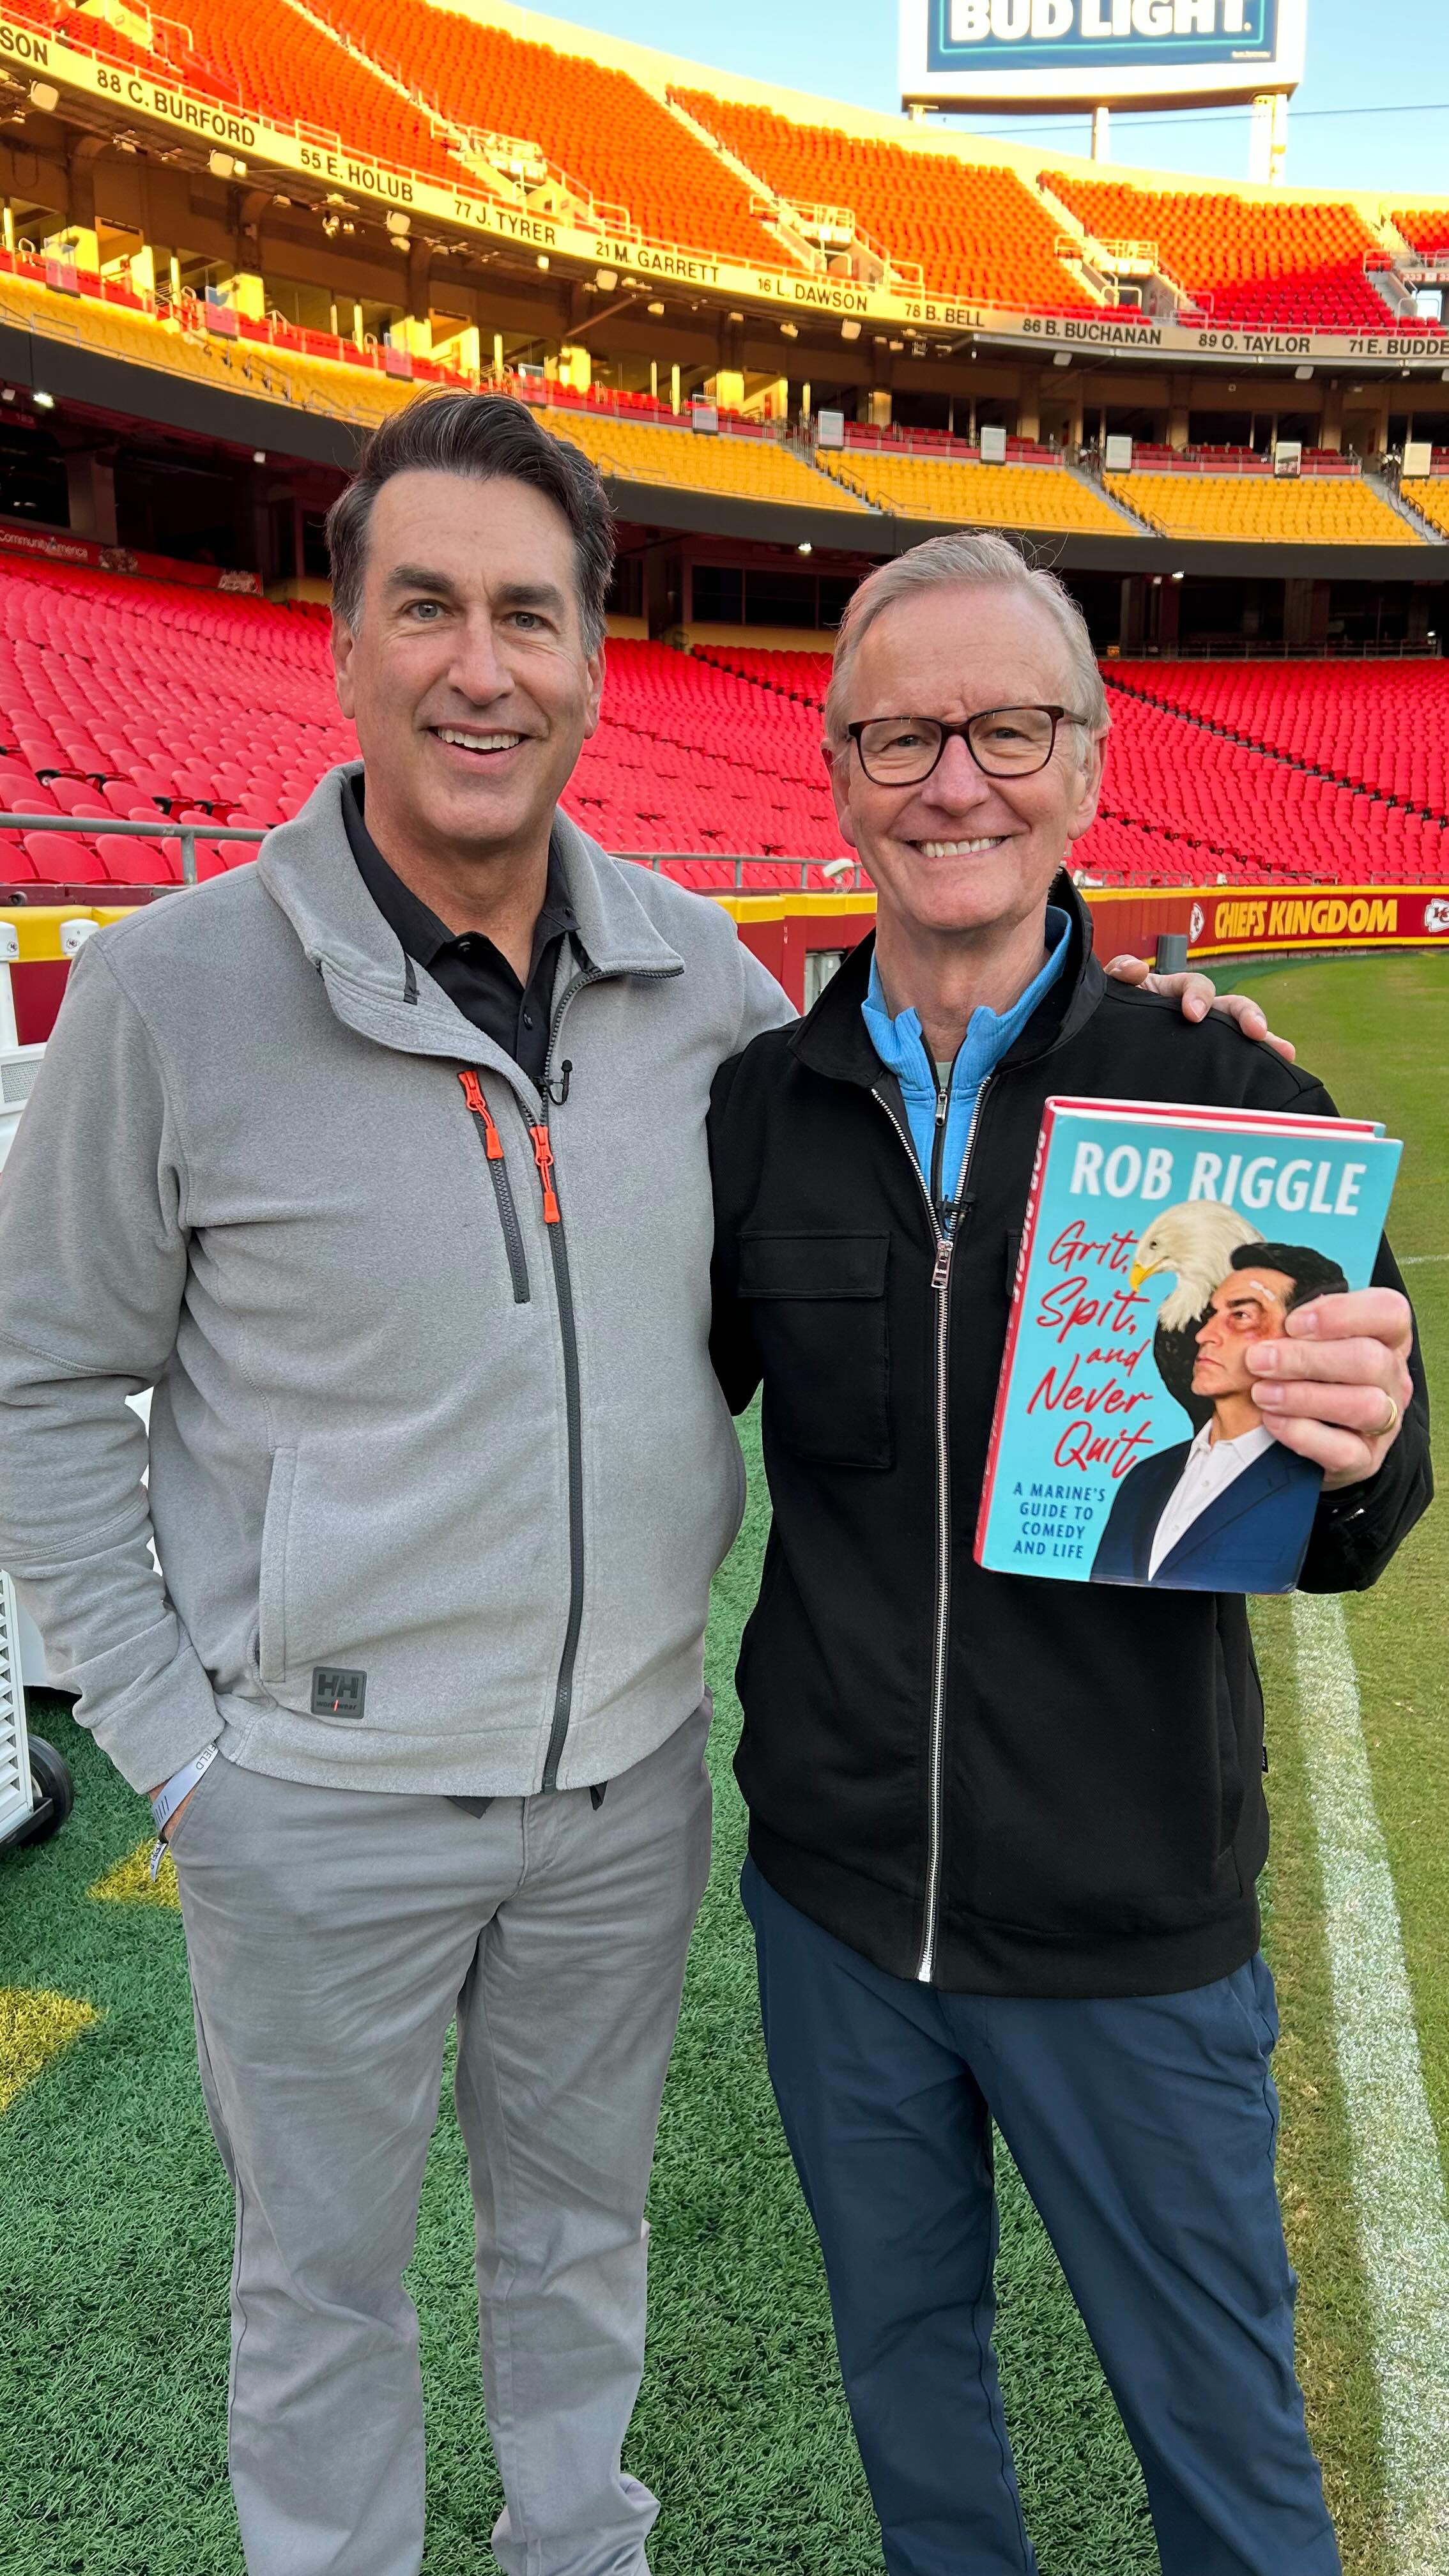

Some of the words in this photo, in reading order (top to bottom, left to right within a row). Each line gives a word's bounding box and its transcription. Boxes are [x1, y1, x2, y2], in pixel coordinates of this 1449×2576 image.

[951, 0, 1073, 41] BUD
[97, 69, 121, 93] 88
[128, 81, 149, 107] C.
[154, 90, 255, 146] BURFORD
[301, 148, 321, 169] 55
[327, 157, 343, 179] E.
[348, 165, 413, 202] HOLUB
[454, 201, 470, 218] 77
[477, 207, 491, 226] J.
[496, 211, 555, 245] TYRER
[596, 241, 609, 257] 21
[615, 244, 631, 263] M.
[638, 250, 719, 282] GARRETT
[758, 278, 771, 292] 16
[777, 283, 790, 297] L.
[795, 284, 868, 311] DAWSON
[905, 303, 920, 318] 78
[926, 305, 940, 322] B.
[946, 308, 985, 327] BELL
[1022, 319, 1040, 333] 86
[1045, 320, 1060, 336] B.
[1064, 323, 1162, 346] BUCHANAN
[1199, 334, 1216, 348] 89
[1222, 334, 1238, 351] O.
[1243, 335, 1310, 353] TAYLOR
[1349, 339, 1363, 353] 71
[1367, 339, 1382, 355] E.
[1386, 339, 1449, 355] BUDDE
[1215, 901, 1268, 939] CHIEFS
[1268, 899, 1397, 936] KINGDOM
[1070, 1140, 1174, 1200] ROB
[1188, 1151, 1367, 1216] RIGGLE
[1048, 1220, 1139, 1274] Grit,
[1036, 1276, 1150, 1343] Spit,
[1085, 1339, 1151, 1377] and
[1026, 1353, 1154, 1414] Never
[1054, 1420, 1154, 1478] Quit
[1013, 1482, 1022, 1496] A
[1030, 1483, 1106, 1502] MARINE'S
[1019, 1501, 1068, 1519] GUIDE
[1075, 1506, 1093, 1520] TO
[1013, 1540, 1046, 1555] AND
[1053, 1543, 1084, 1559] LIFE
[1022, 1521, 1085, 1539] COMEDY
[196, 1742, 217, 1770] FIELD
